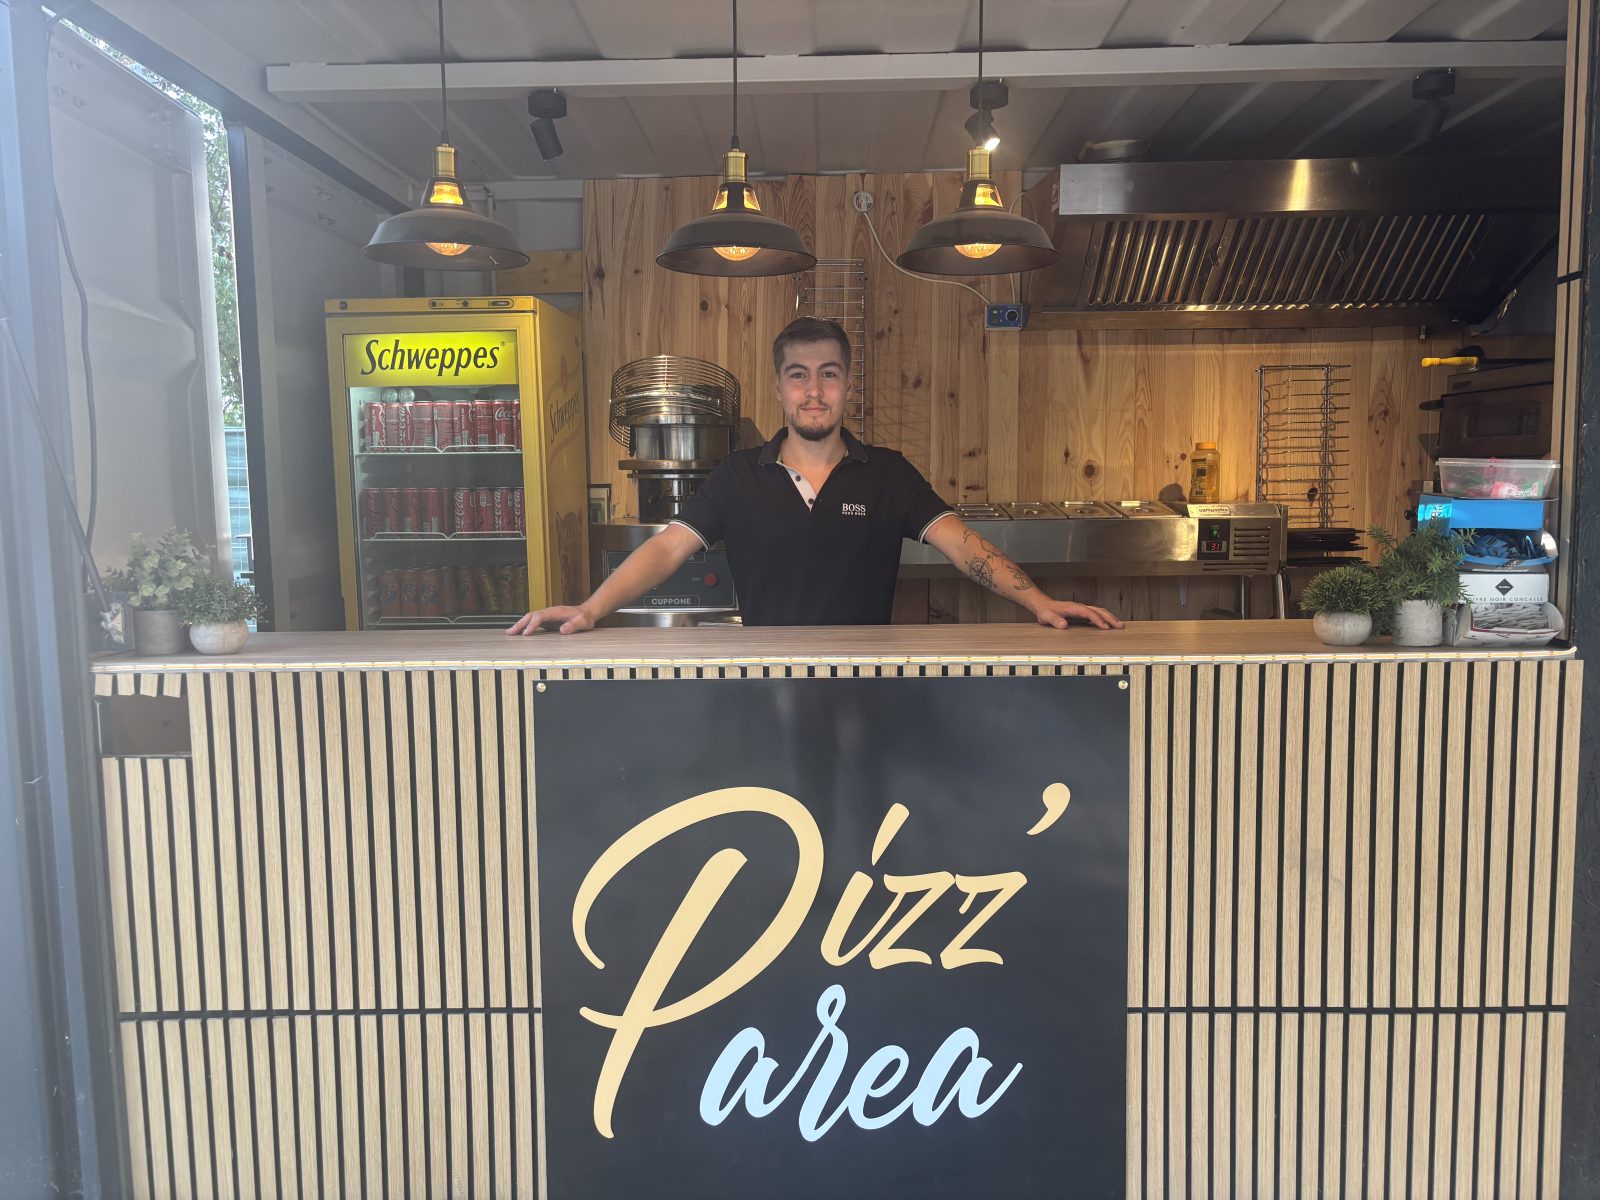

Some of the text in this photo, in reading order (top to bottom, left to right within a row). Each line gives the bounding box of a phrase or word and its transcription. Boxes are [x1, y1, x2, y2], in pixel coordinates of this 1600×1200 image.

[360, 339, 500, 377] Schweppes
[549, 391, 580, 444] Schweppes
[842, 503, 866, 512] BOSS
